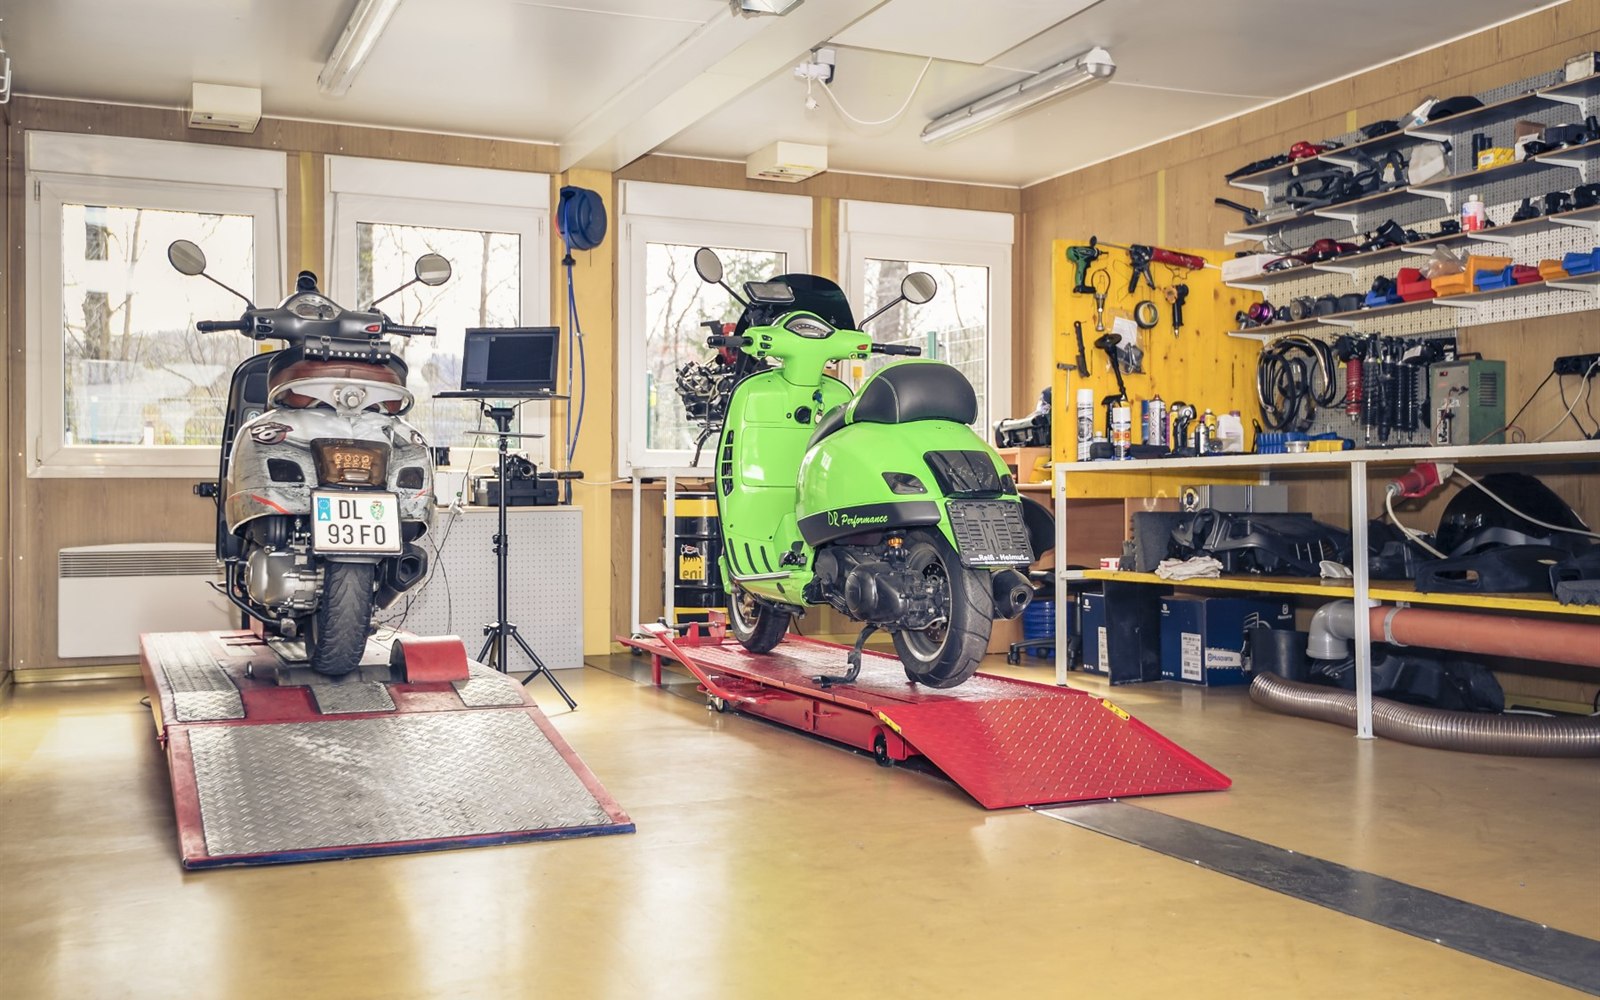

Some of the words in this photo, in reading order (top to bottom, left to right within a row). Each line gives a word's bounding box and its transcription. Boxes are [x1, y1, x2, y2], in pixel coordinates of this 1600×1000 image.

[338, 499, 363, 520] DL
[827, 511, 840, 527] DR
[841, 513, 888, 528] Performance
[328, 523, 354, 545] 93
[360, 524, 386, 545] FO
[682, 566, 702, 580] eni
